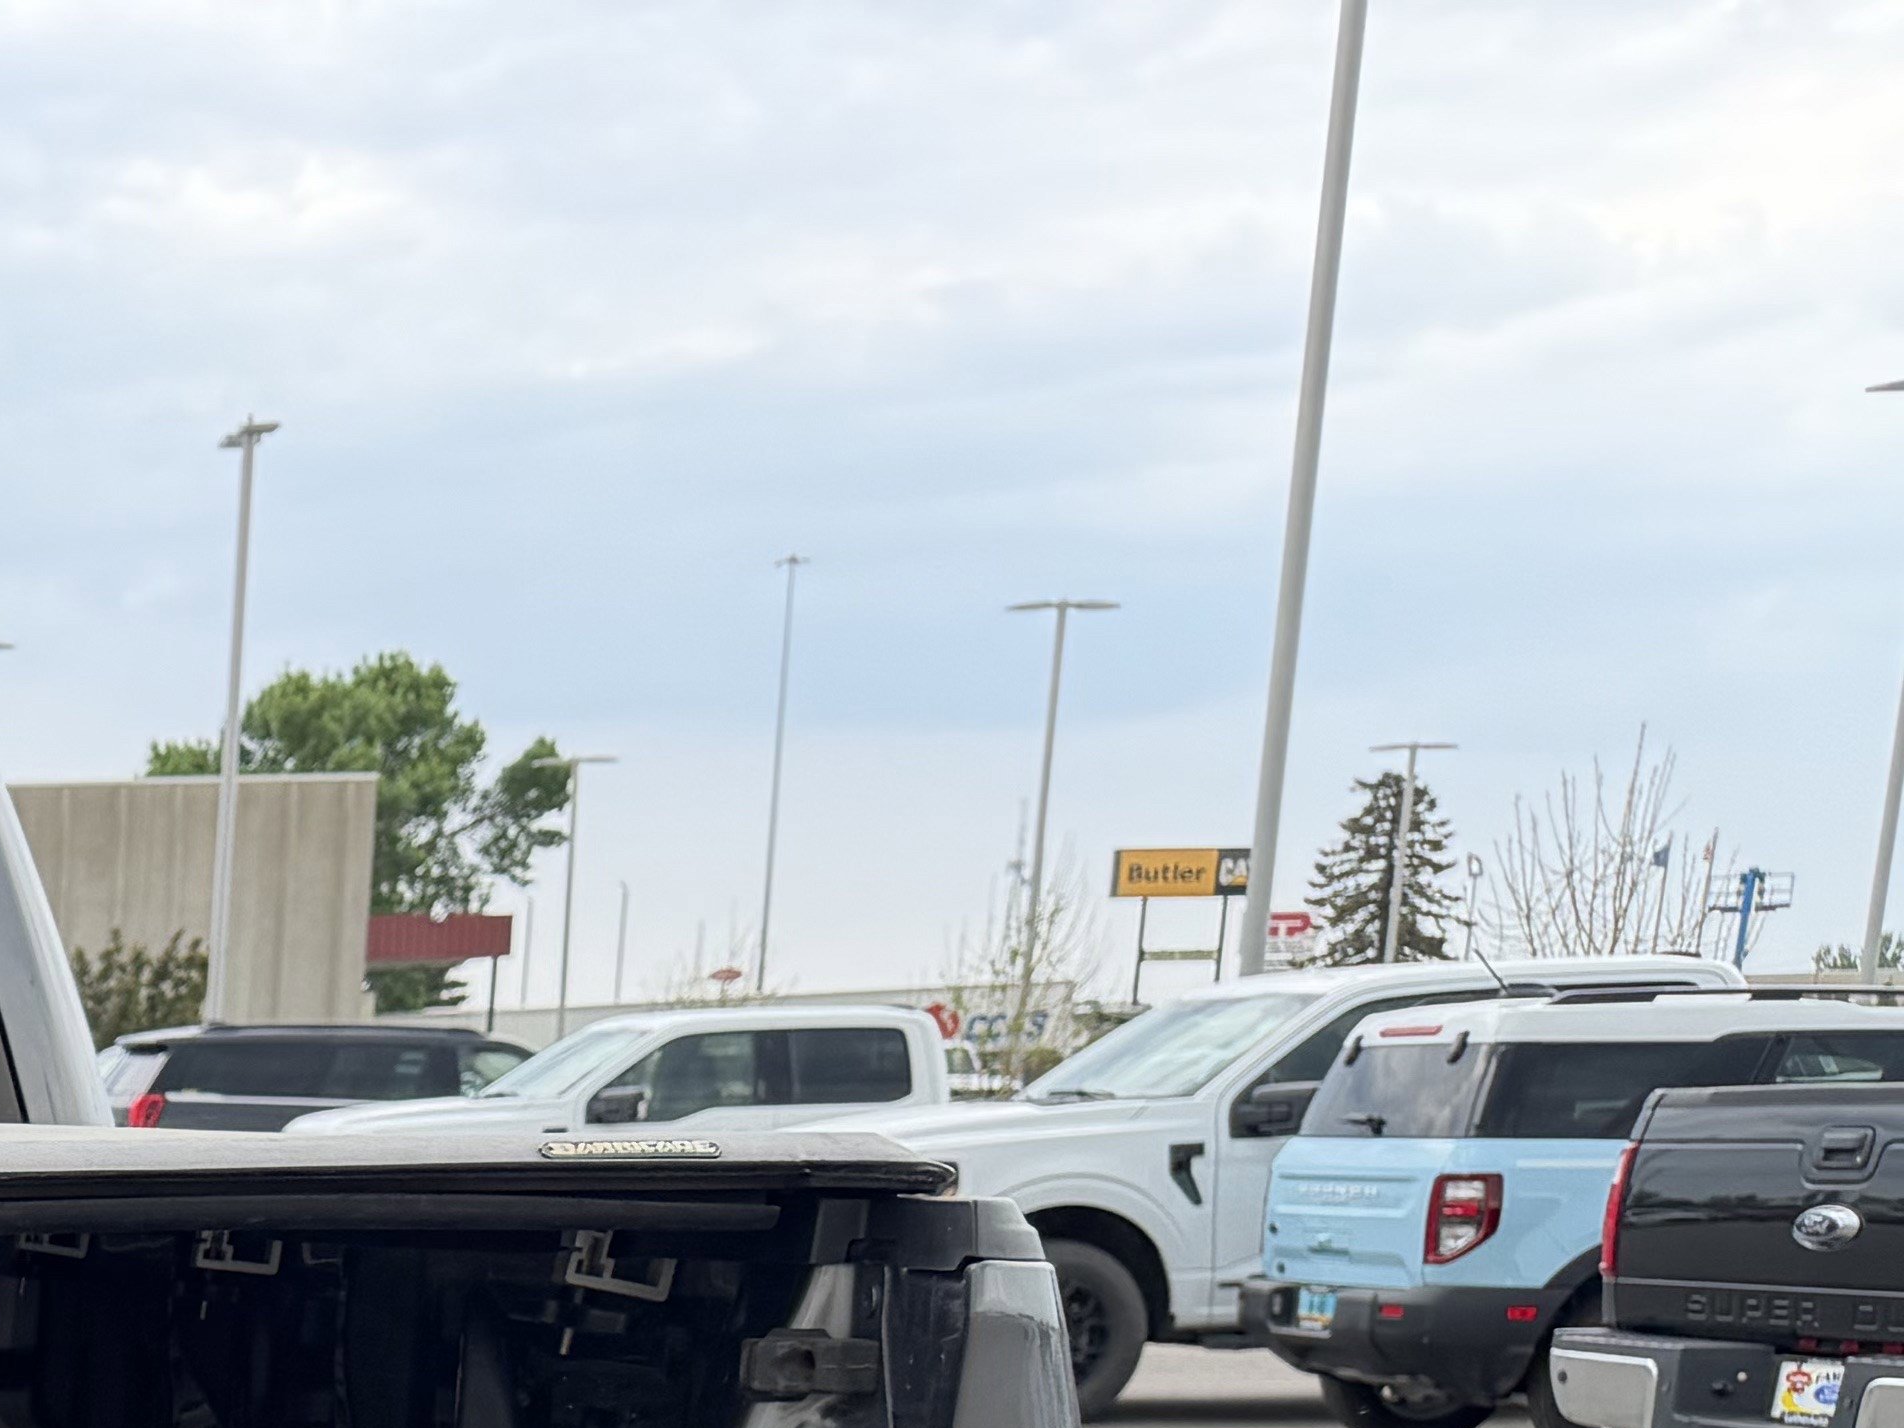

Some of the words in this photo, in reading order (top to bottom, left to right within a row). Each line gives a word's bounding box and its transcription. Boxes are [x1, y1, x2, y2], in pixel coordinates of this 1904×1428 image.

[1128, 863, 1207, 884] Butler
[1218, 857, 1249, 887] CA
[1686, 1293, 1820, 1328] SUPER
